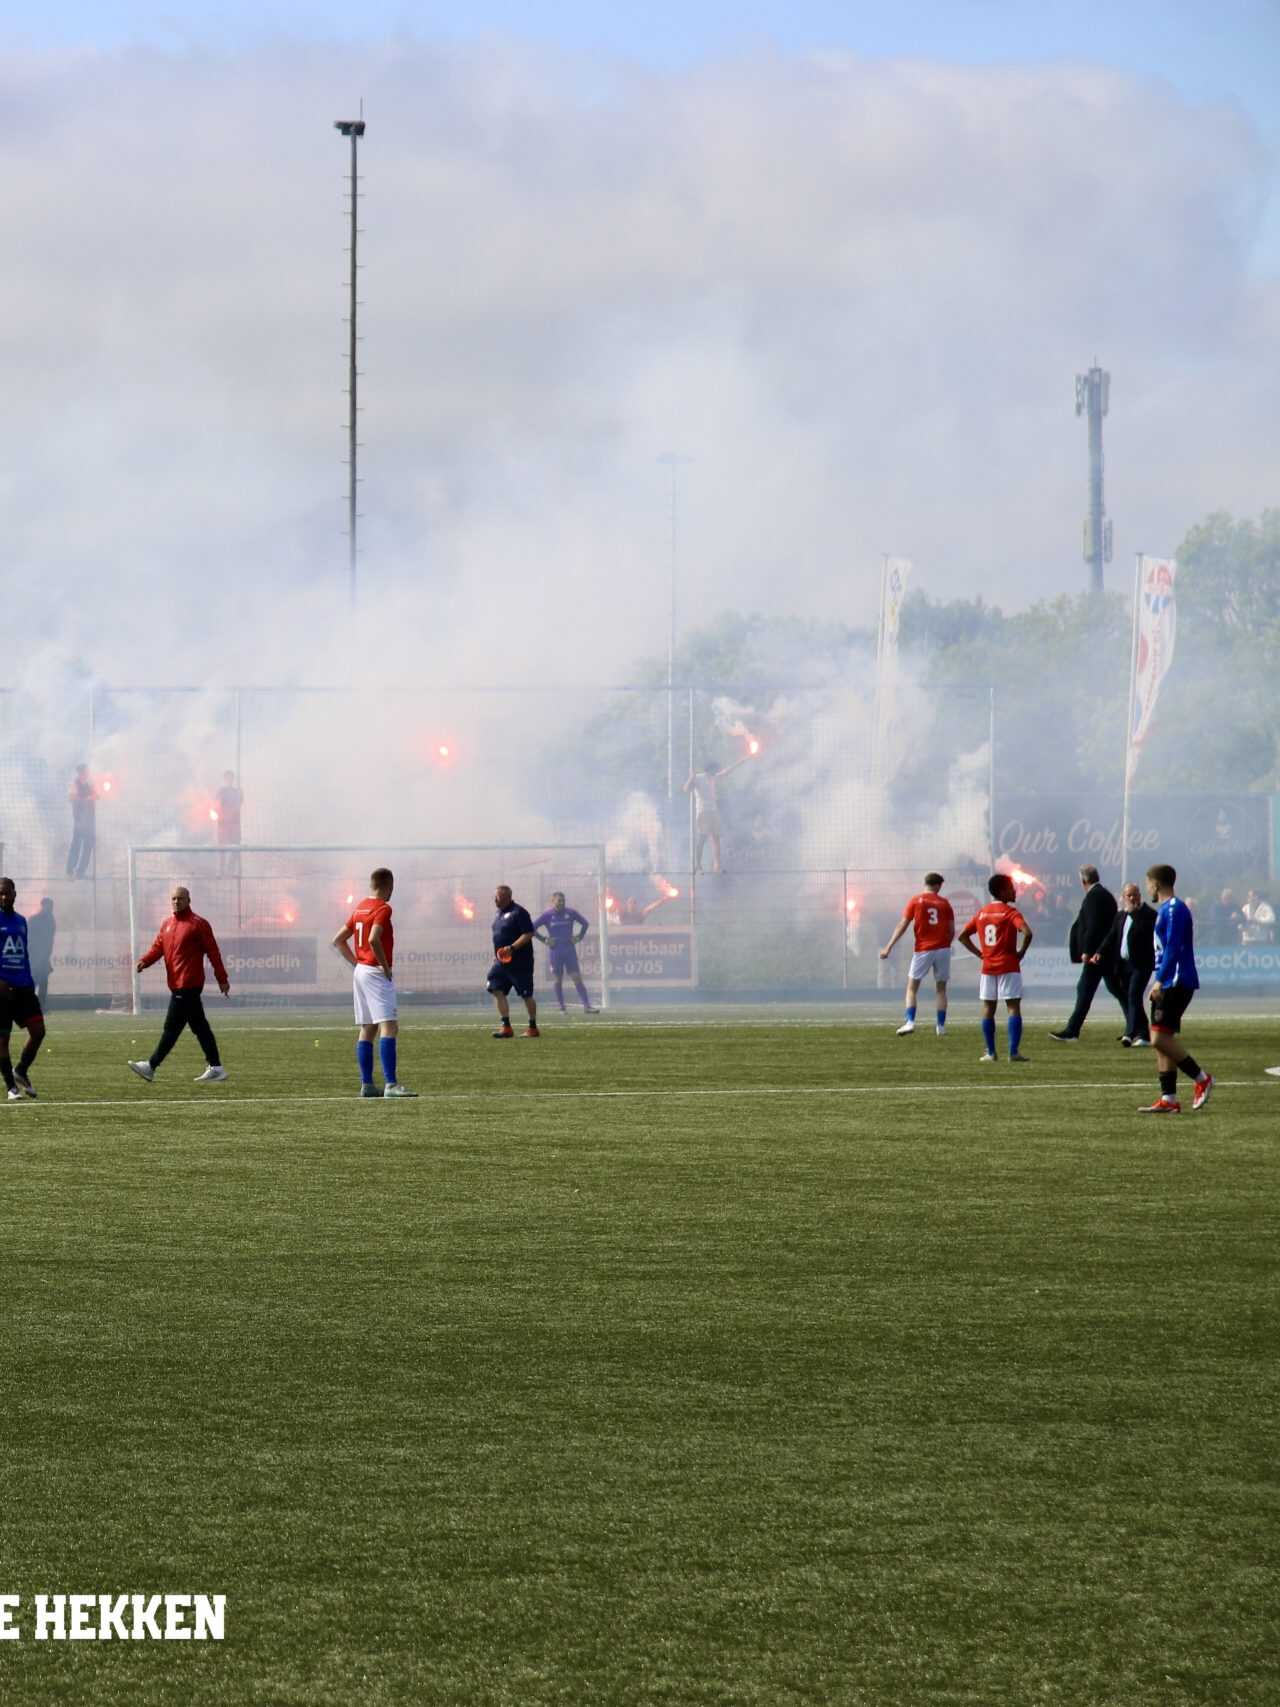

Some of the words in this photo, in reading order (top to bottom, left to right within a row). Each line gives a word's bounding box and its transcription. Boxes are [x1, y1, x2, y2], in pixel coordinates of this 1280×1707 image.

[998, 819, 1058, 854] Our
[1067, 818, 1160, 866] Coffee
[927, 908, 939, 926] 3
[984, 924, 997, 947] 8
[607, 940, 686, 957] ereikbaar
[226, 954, 301, 973] Spoedlijn
[624, 960, 664, 976] 0705
